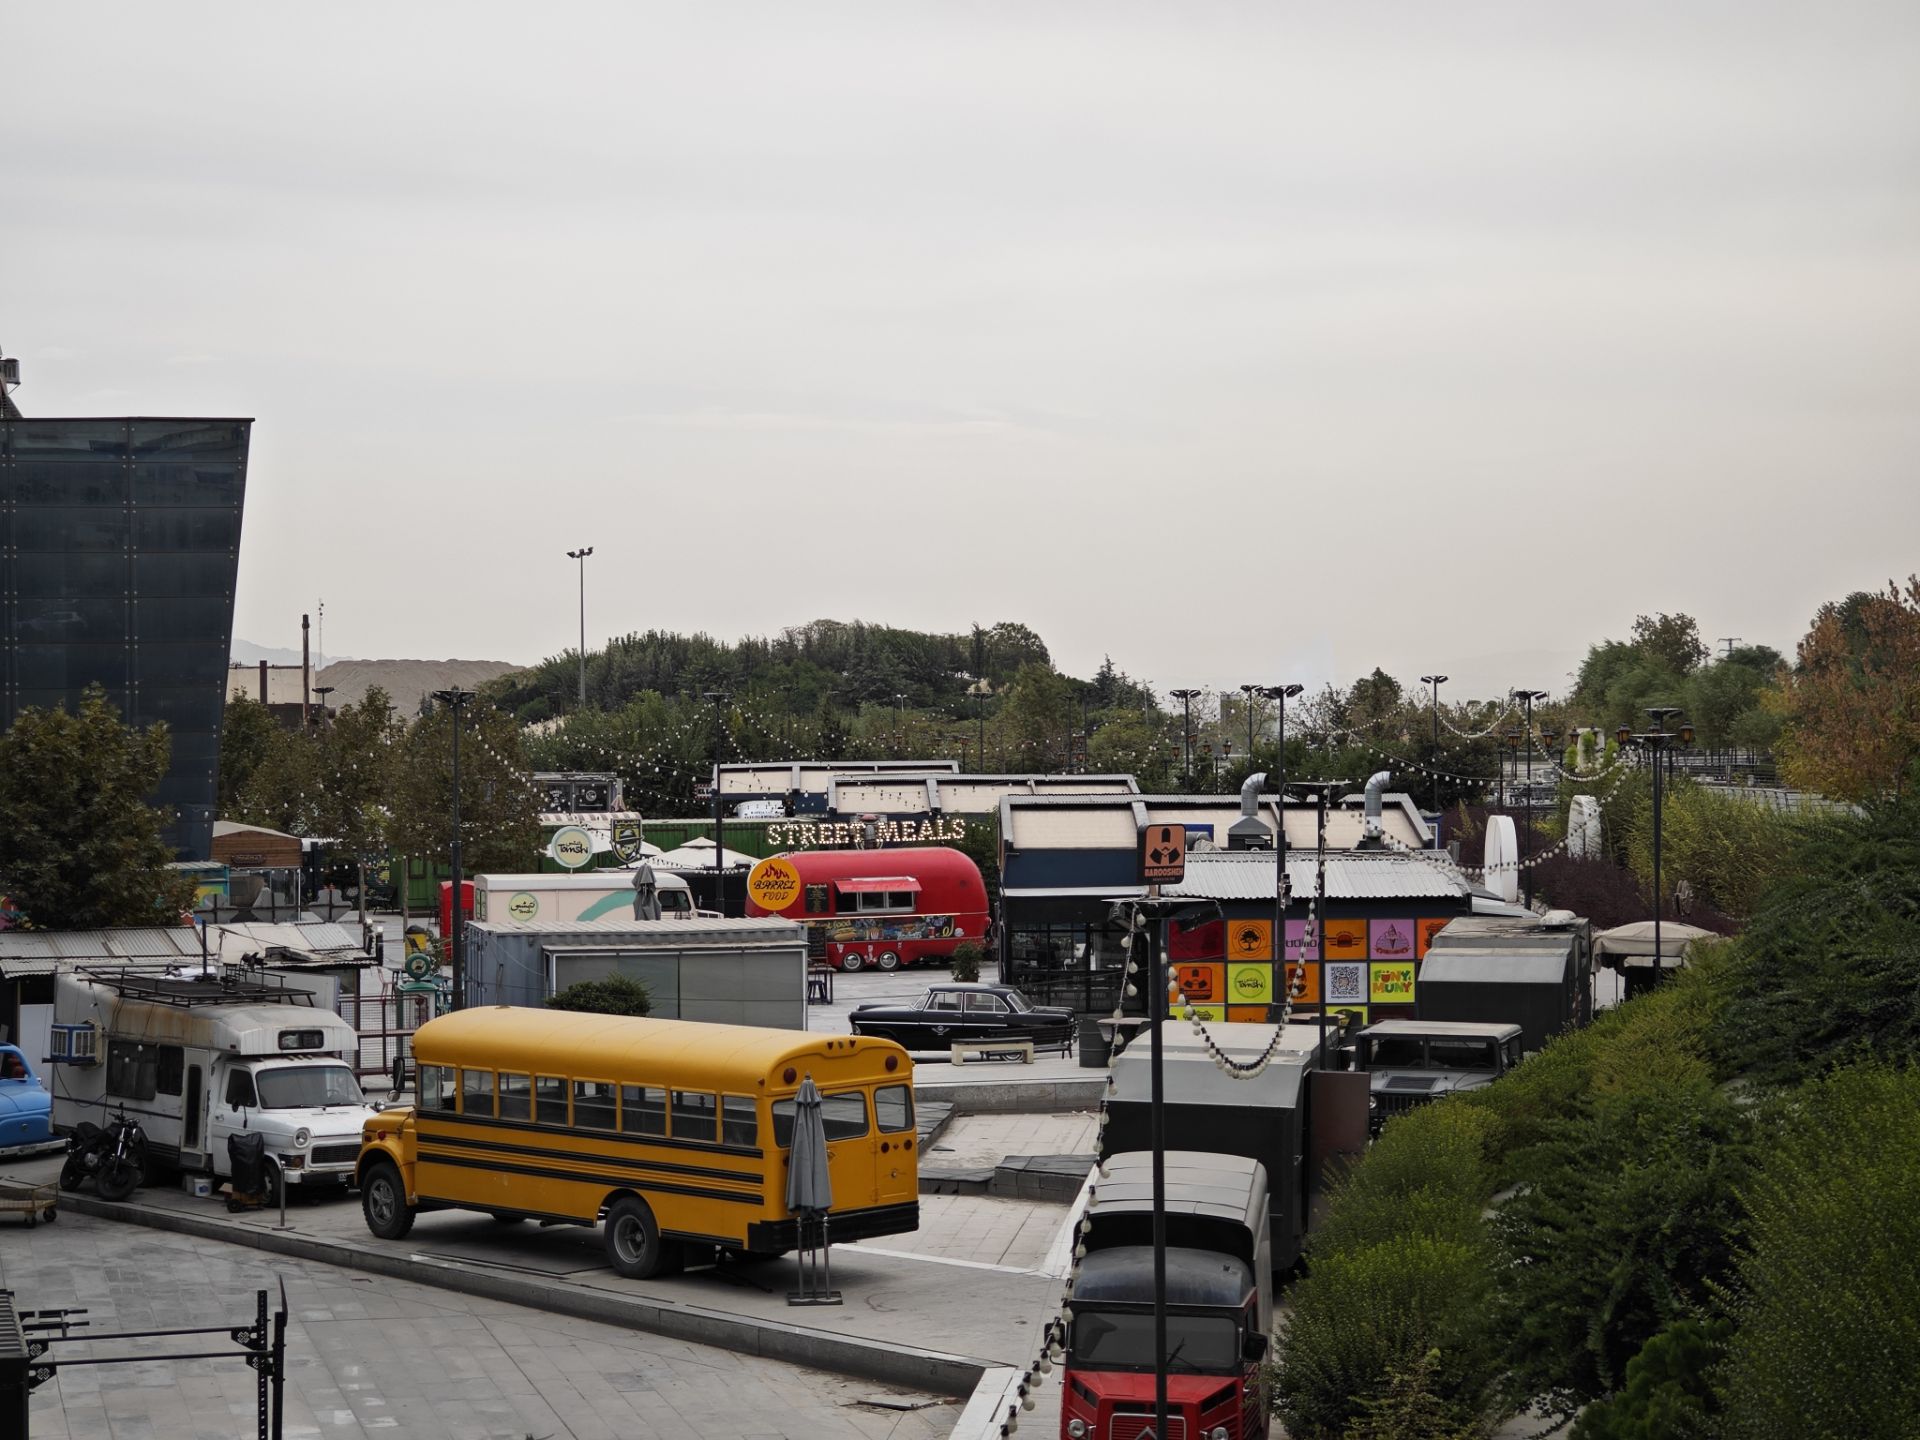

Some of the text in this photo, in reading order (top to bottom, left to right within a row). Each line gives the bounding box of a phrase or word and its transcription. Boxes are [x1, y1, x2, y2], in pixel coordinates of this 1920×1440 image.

[768, 819, 966, 845] STREET MEALS
[753, 880, 796, 890] BARREL
[762, 891, 789, 900] FOOD
[1372, 982, 1413, 994] MUNY
